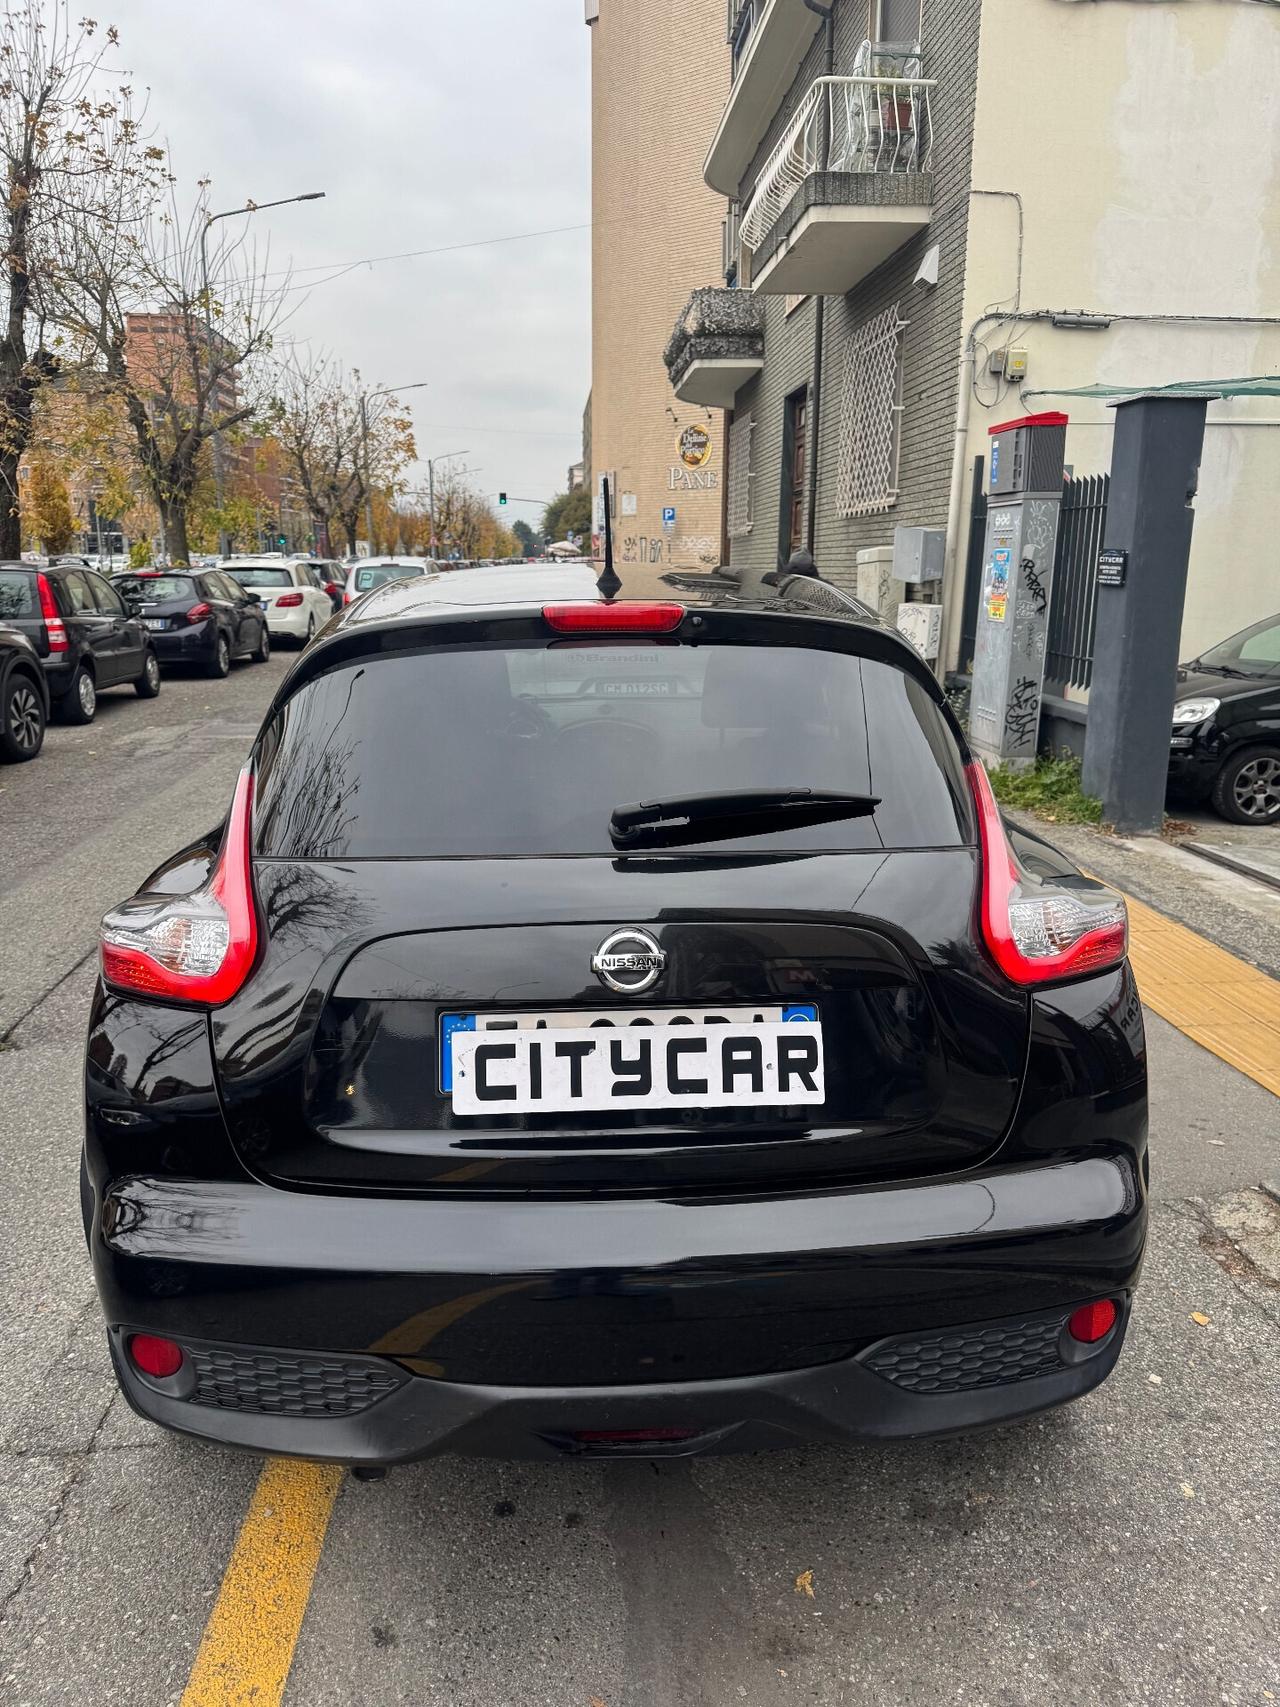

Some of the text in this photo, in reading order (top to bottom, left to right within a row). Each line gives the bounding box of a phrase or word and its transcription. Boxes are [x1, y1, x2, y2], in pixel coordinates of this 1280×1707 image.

[669, 468, 718, 490] PANE
[665, 509, 673, 520] P
[601, 956, 657, 968] NISSAN
[475, 1035, 819, 1100] CITYCAR
